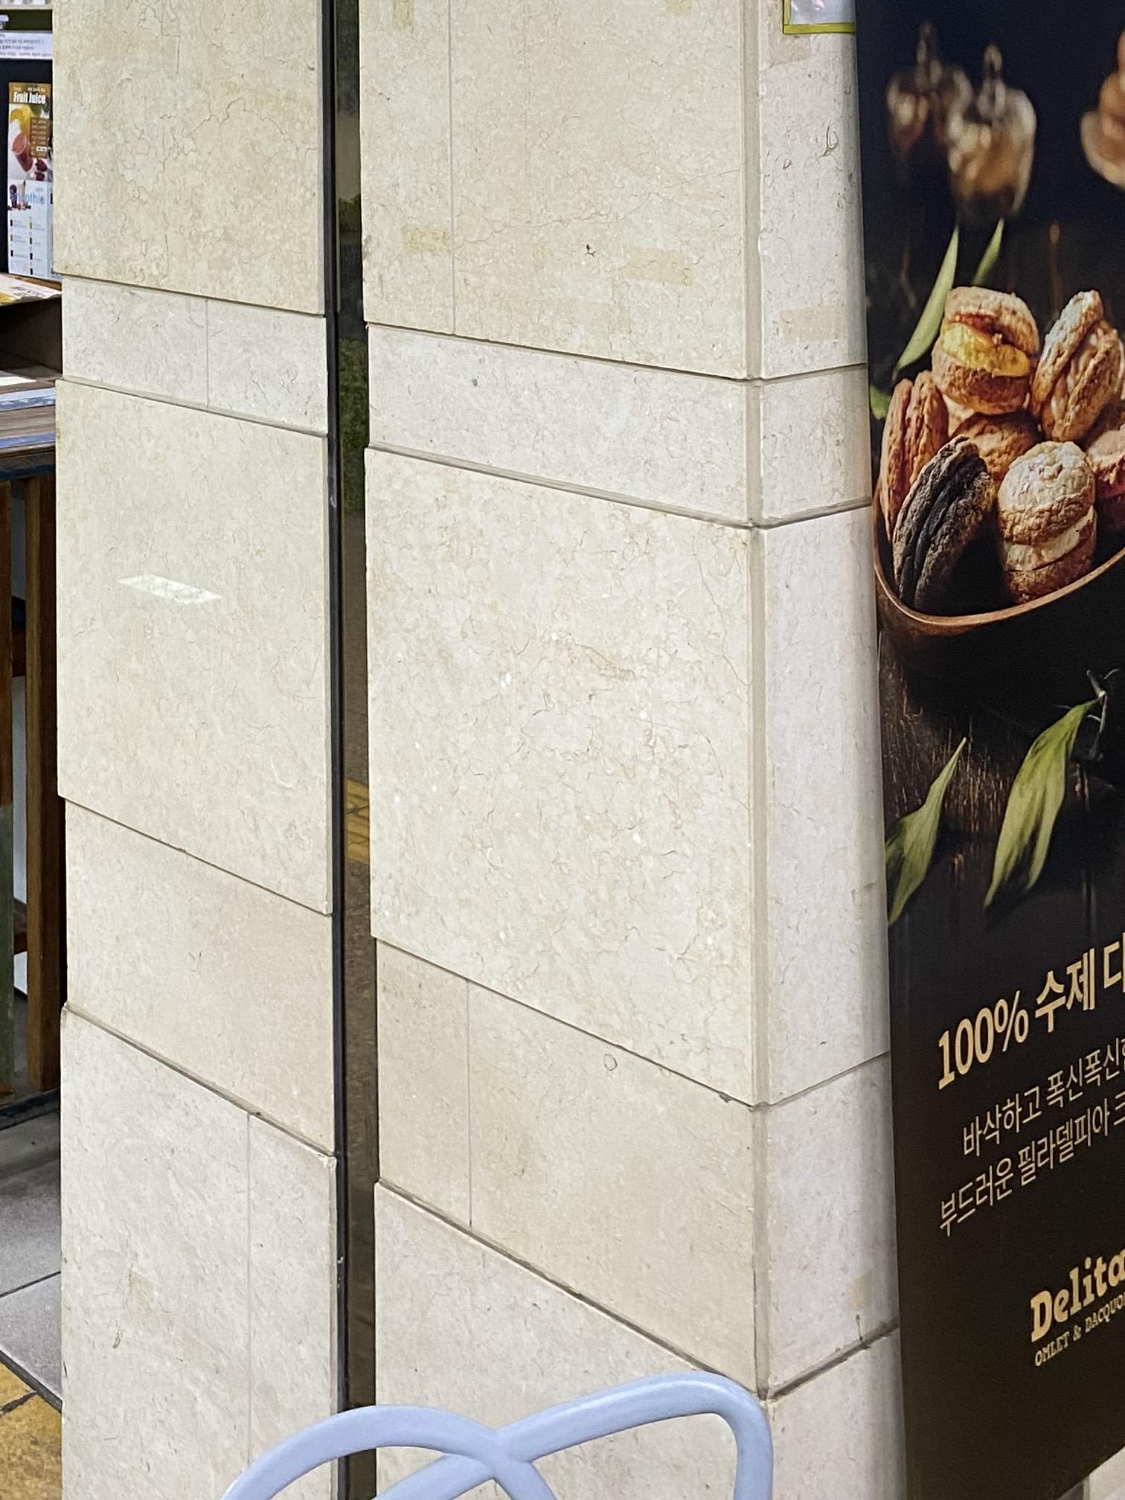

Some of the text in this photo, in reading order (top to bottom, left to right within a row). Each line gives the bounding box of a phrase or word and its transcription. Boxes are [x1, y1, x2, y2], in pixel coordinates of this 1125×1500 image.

[13, 91, 46, 104] Fruit Juice
[938, 990, 1029, 1090] 100%
[1035, 947, 1095, 1033] 수제
[963, 1085, 1042, 1157] 바삭하고
[939, 1157, 1014, 1237] 부드러운
[1018, 1097, 1111, 1187] 필라델피아
[1035, 1330, 1070, 1367] OMLET
[1072, 1324, 1082, 1341] &
